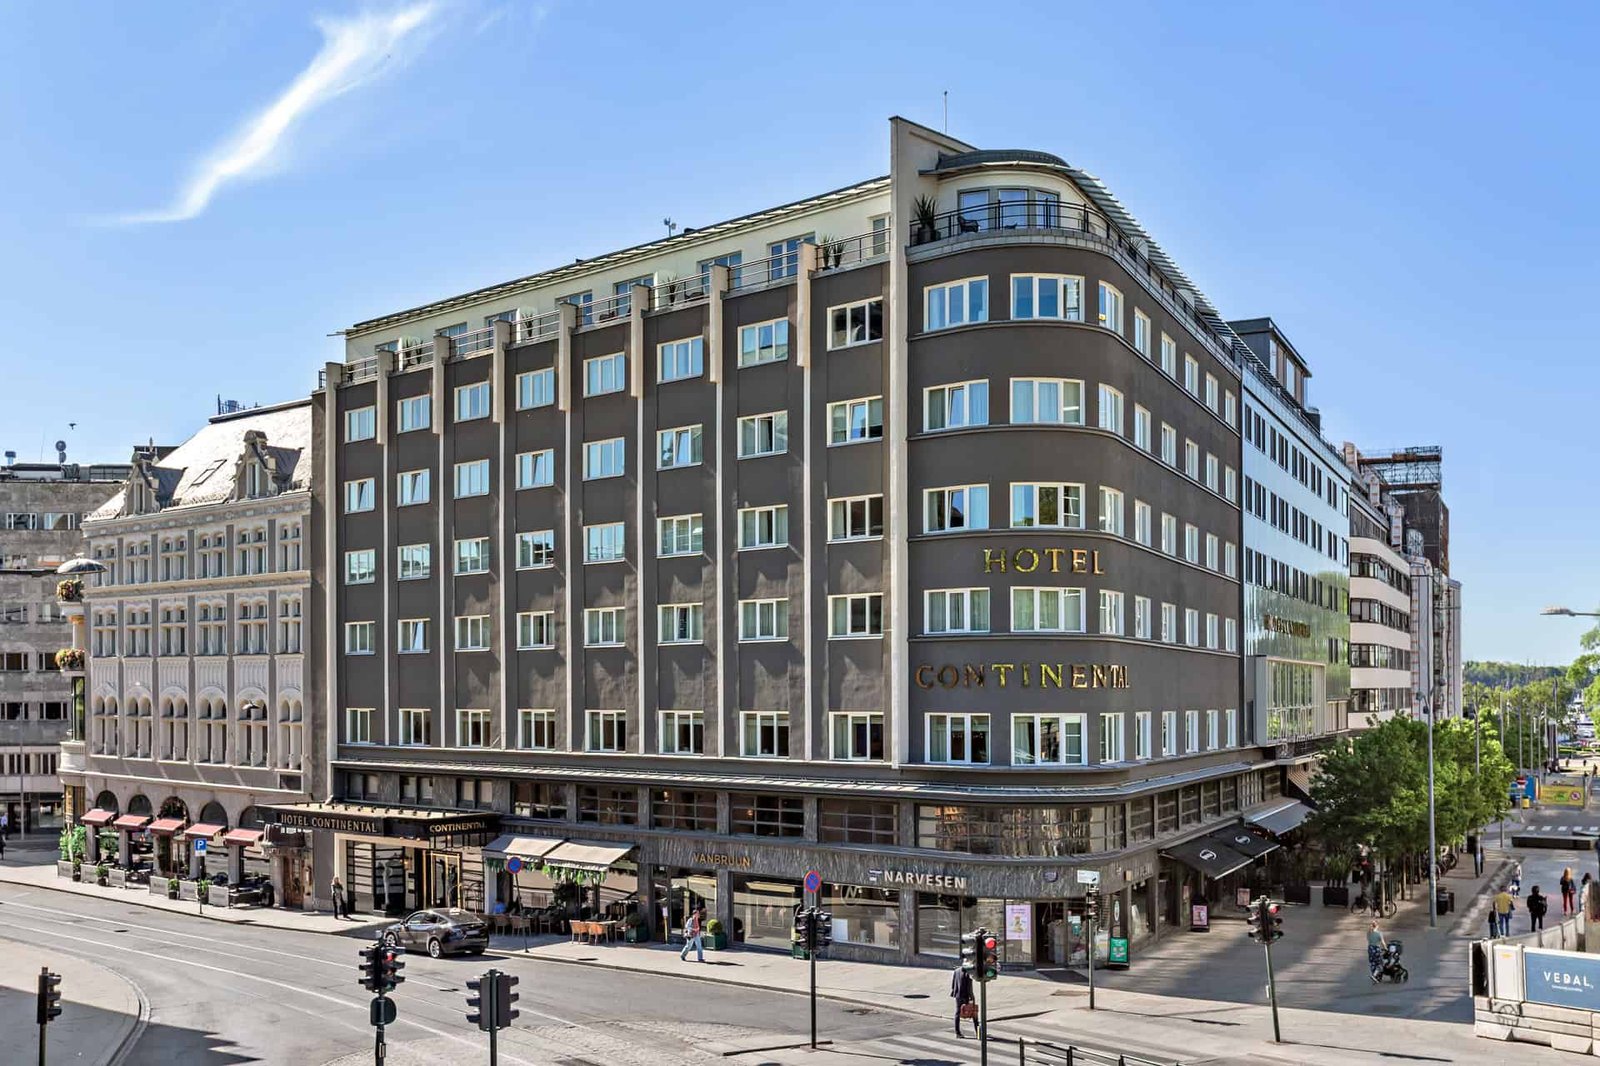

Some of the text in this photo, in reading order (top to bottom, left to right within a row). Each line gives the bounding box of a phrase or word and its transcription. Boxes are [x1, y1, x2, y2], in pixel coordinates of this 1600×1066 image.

[983, 548, 1105, 574] HOTEL
[914, 663, 1130, 689] CONTINENTAL
[280, 813, 378, 833] HOTEL CONTINENTAL
[430, 821, 487, 832] CONTINENTAL
[884, 870, 967, 889] NARVESEN
